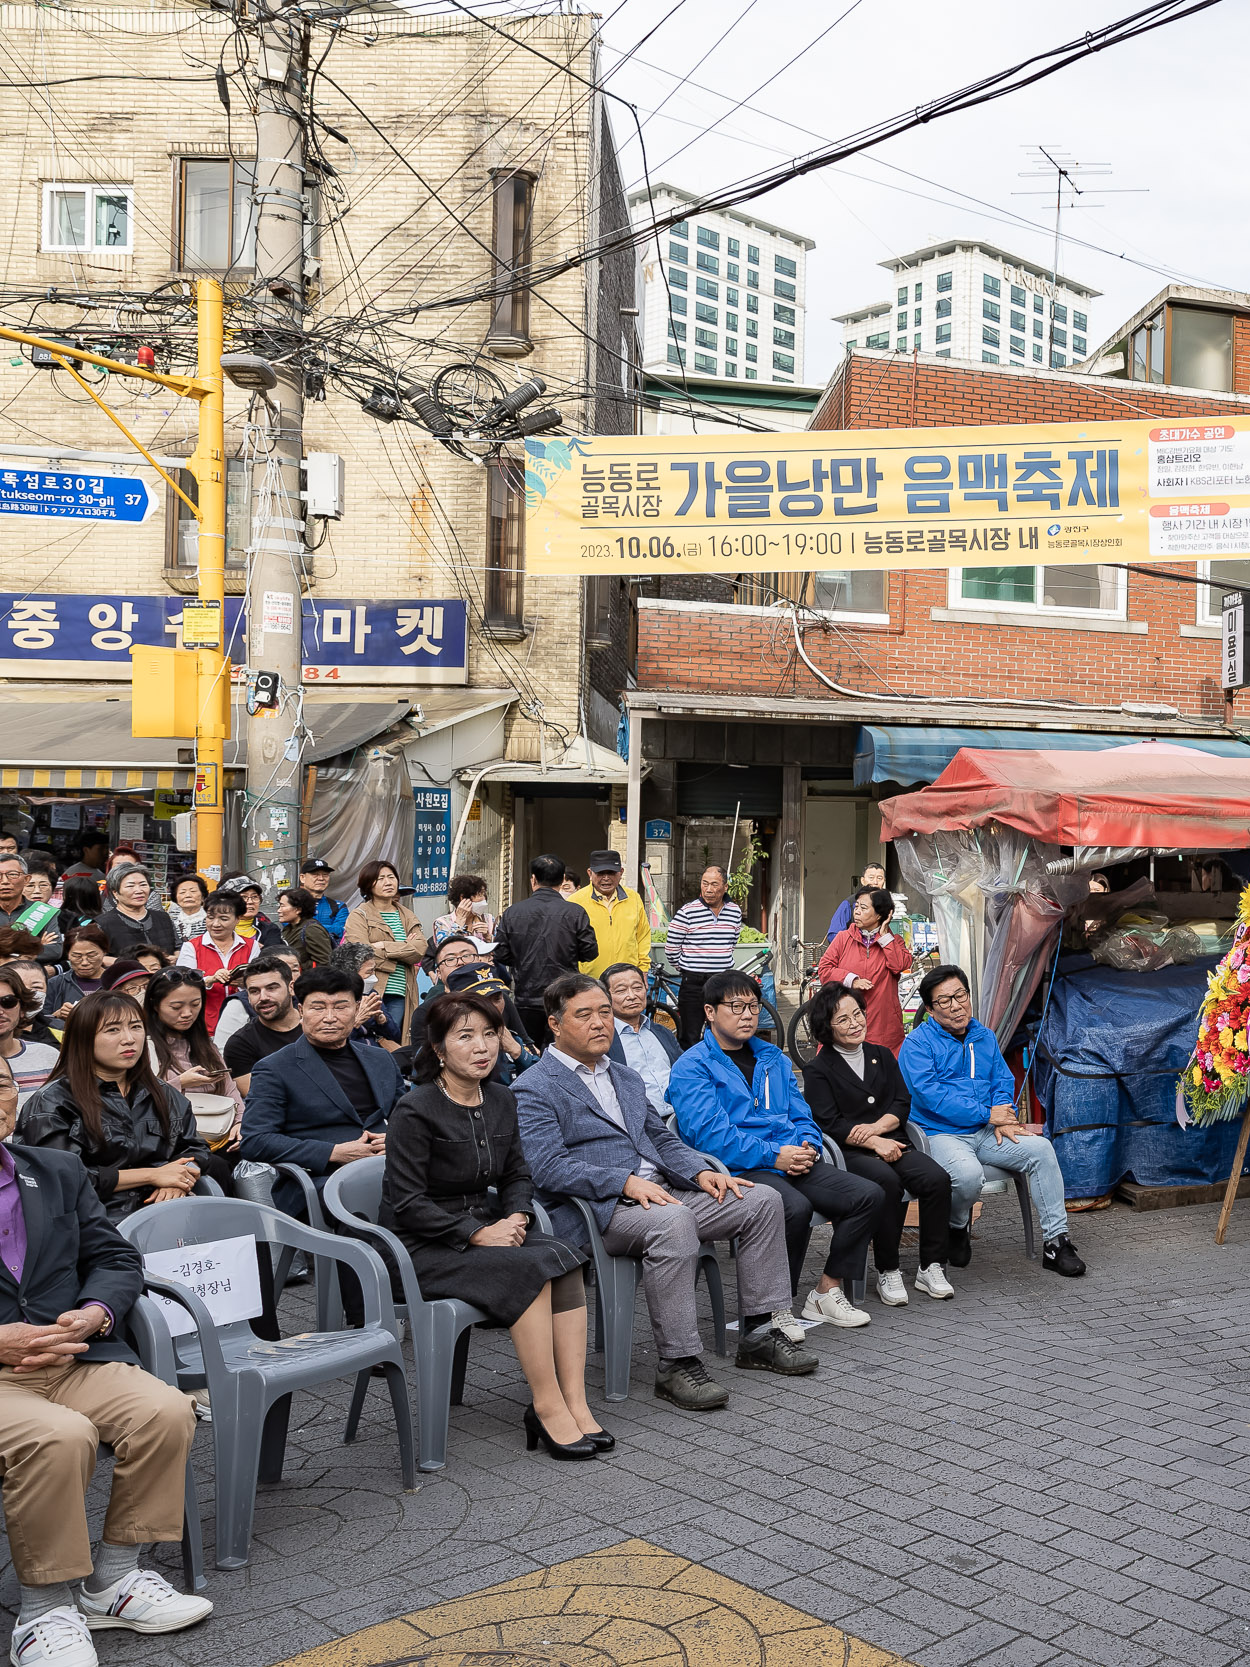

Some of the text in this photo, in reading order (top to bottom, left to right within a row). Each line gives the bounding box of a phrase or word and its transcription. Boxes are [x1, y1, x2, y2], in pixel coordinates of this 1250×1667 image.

[1159, 427, 1225, 440] 초대가수 공연
[1157, 453, 1201, 464] 홍삼트리오
[2, 471, 105, 495] 뚝섬로30길
[580, 462, 661, 494] 능동로
[669, 448, 1121, 518] 가을낭만 음맥축제
[1157, 477, 1183, 487] 사회자
[1190, 475, 1233, 486] KBS리포터
[0, 487, 142, 507] tukseom-ro 30-gil 37
[580, 494, 663, 519] 골목시장
[1169, 504, 1211, 516] 음맥축제
[1064, 525, 1089, 534] 광진구
[1162, 520, 1183, 531] 행사
[1186, 519, 1206, 530] 기간
[1208, 519, 1219, 529] 내
[1221, 518, 1242, 529] 시장
[580, 544, 614, 559] 2023.
[707, 532, 843, 558] 16:00~19:00
[863, 527, 1011, 556] 능동로골목시장
[1018, 526, 1040, 550] 내
[1047, 538, 1123, 549] 능동로골목시장상인회
[1228, 610, 1237, 685] 미용실
[416, 792, 448, 808] 사원모집
[416, 882, 447, 893] 498-6828
